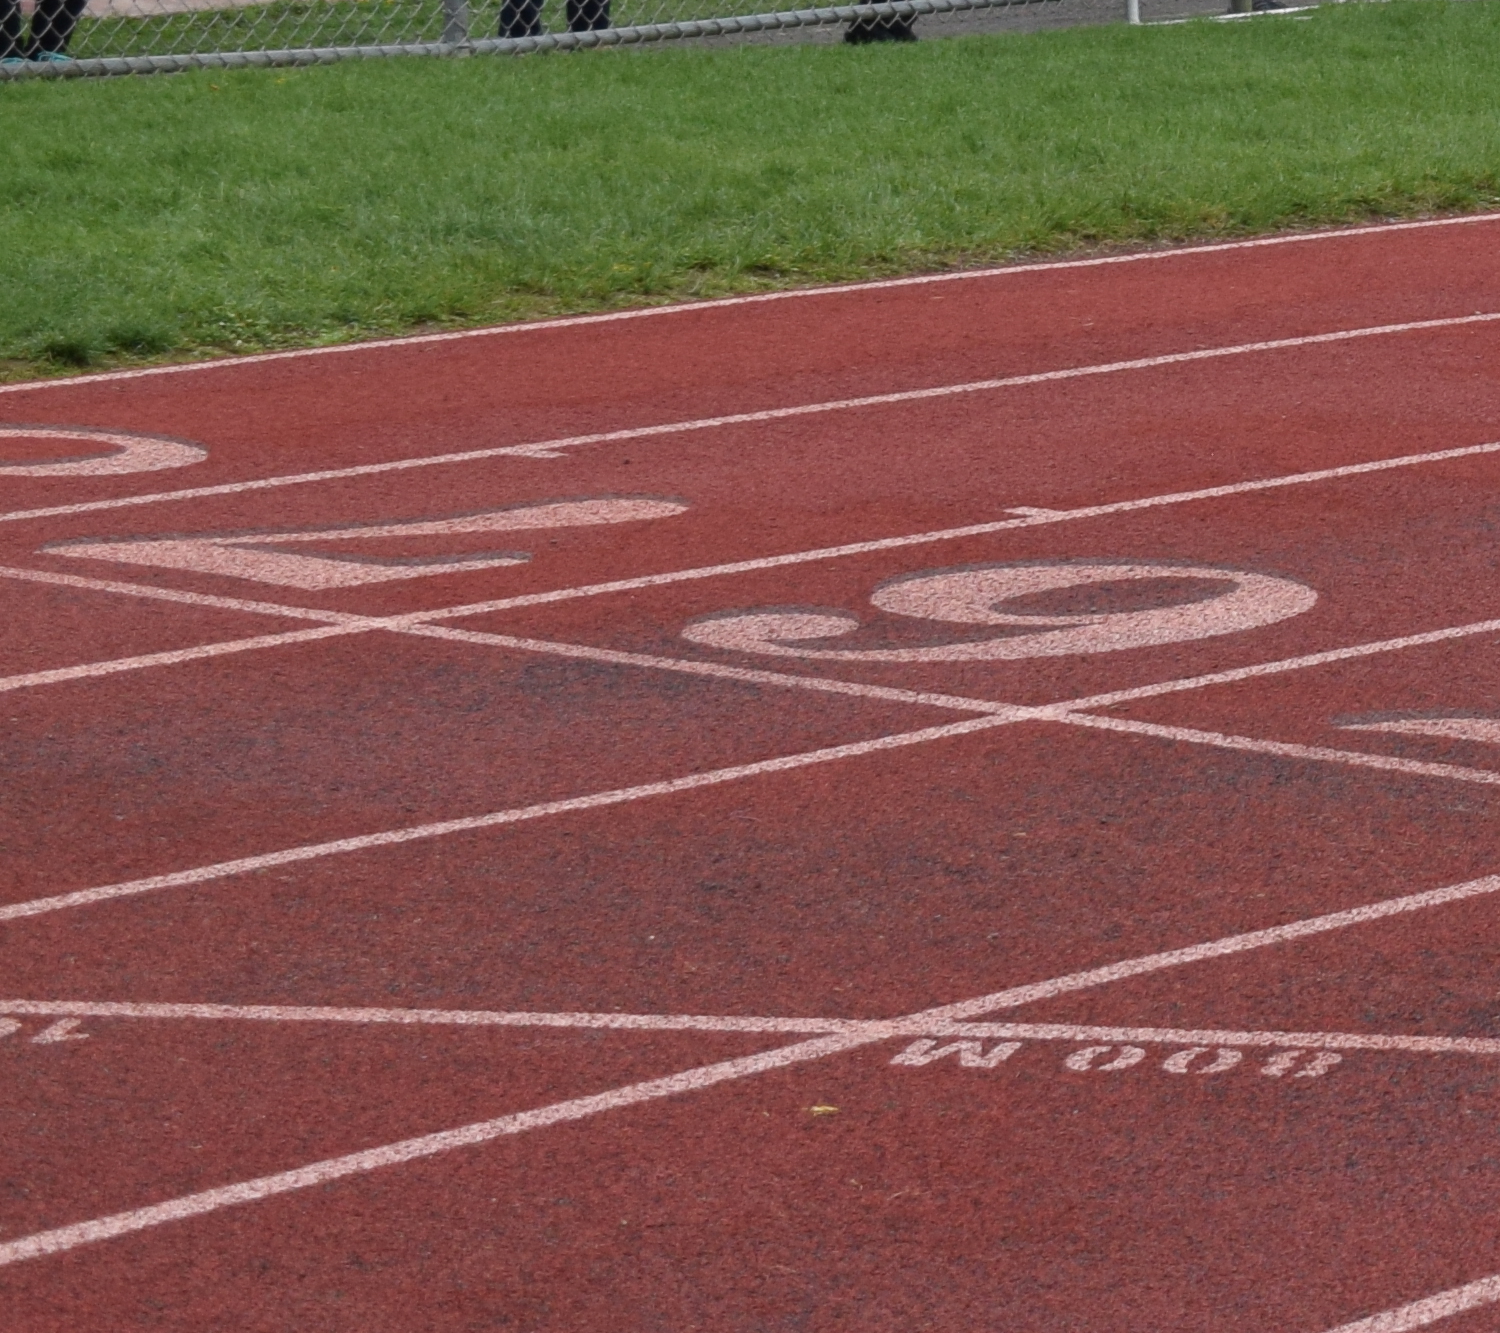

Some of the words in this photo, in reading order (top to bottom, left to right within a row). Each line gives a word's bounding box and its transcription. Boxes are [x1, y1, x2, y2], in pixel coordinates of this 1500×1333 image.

[38, 496, 691, 591] 7
[680, 560, 1319, 662] 6
[889, 1036, 1022, 1069] M
[1062, 1043, 1344, 1078] 800
